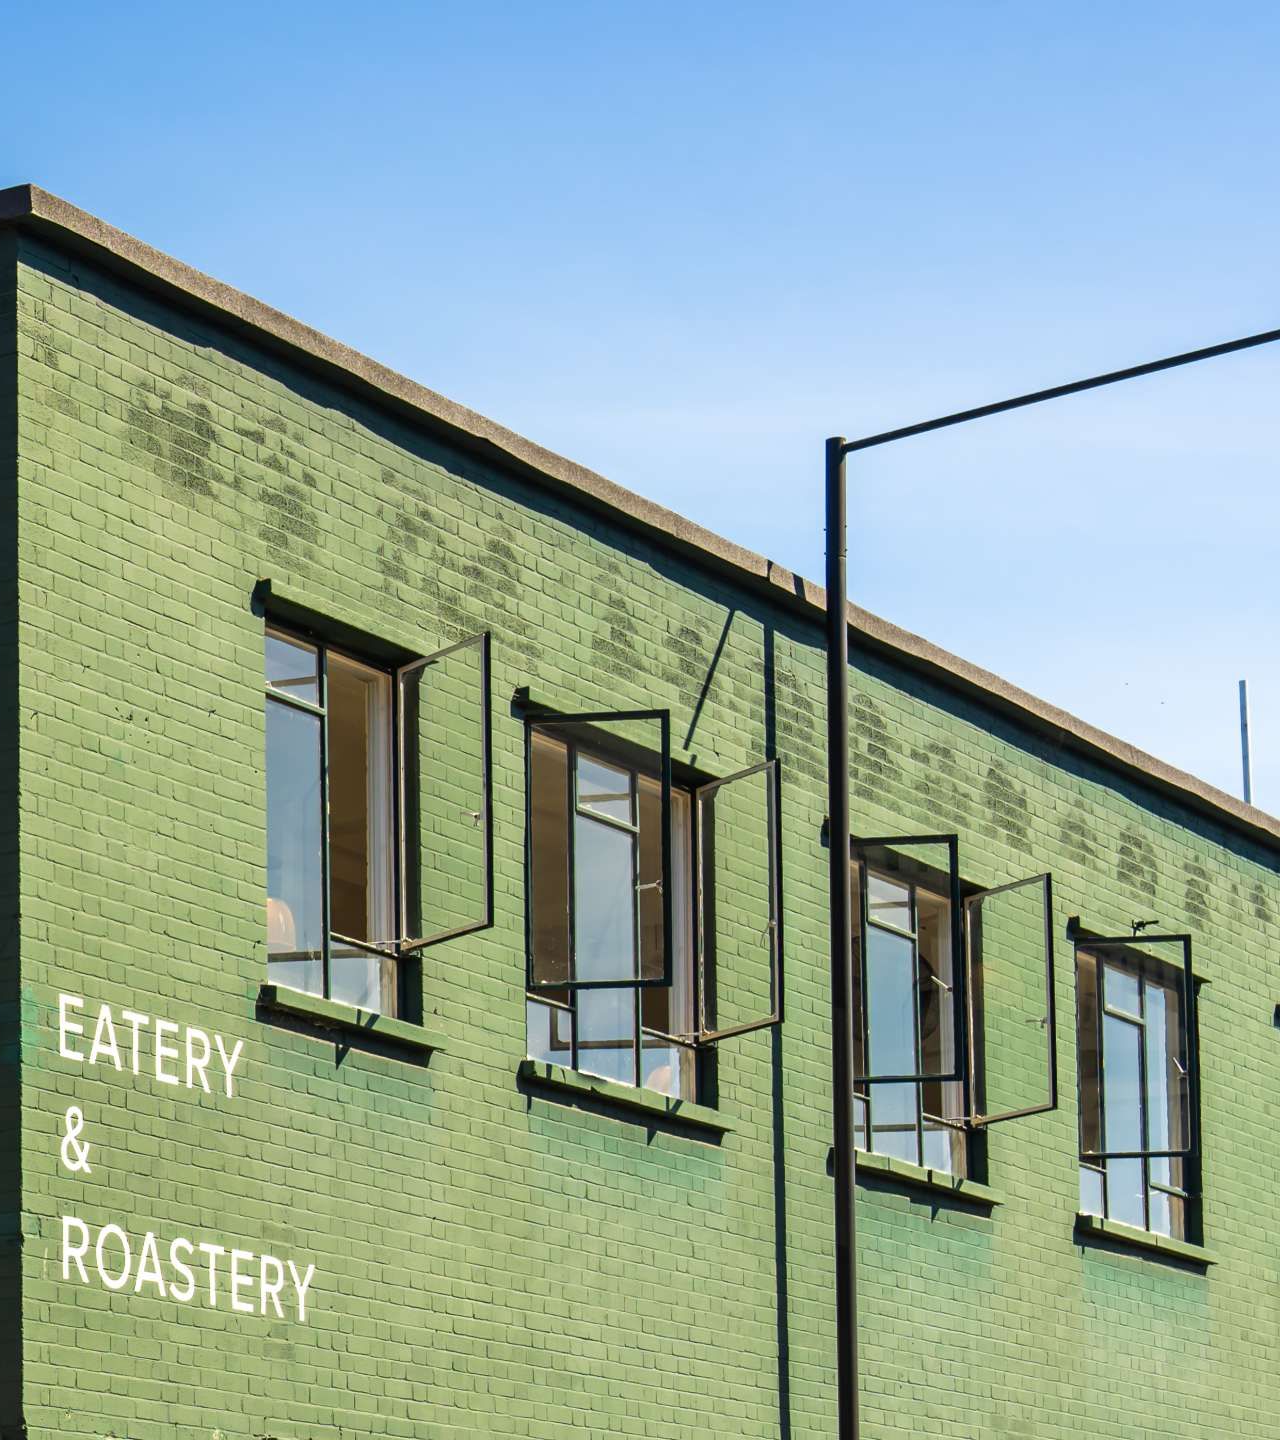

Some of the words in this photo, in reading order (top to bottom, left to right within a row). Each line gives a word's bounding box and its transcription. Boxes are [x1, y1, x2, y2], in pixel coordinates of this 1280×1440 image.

[58, 994, 244, 1098] EATERY
[60, 1105, 92, 1174] &
[60, 1216, 316, 1321] ROASTERY
